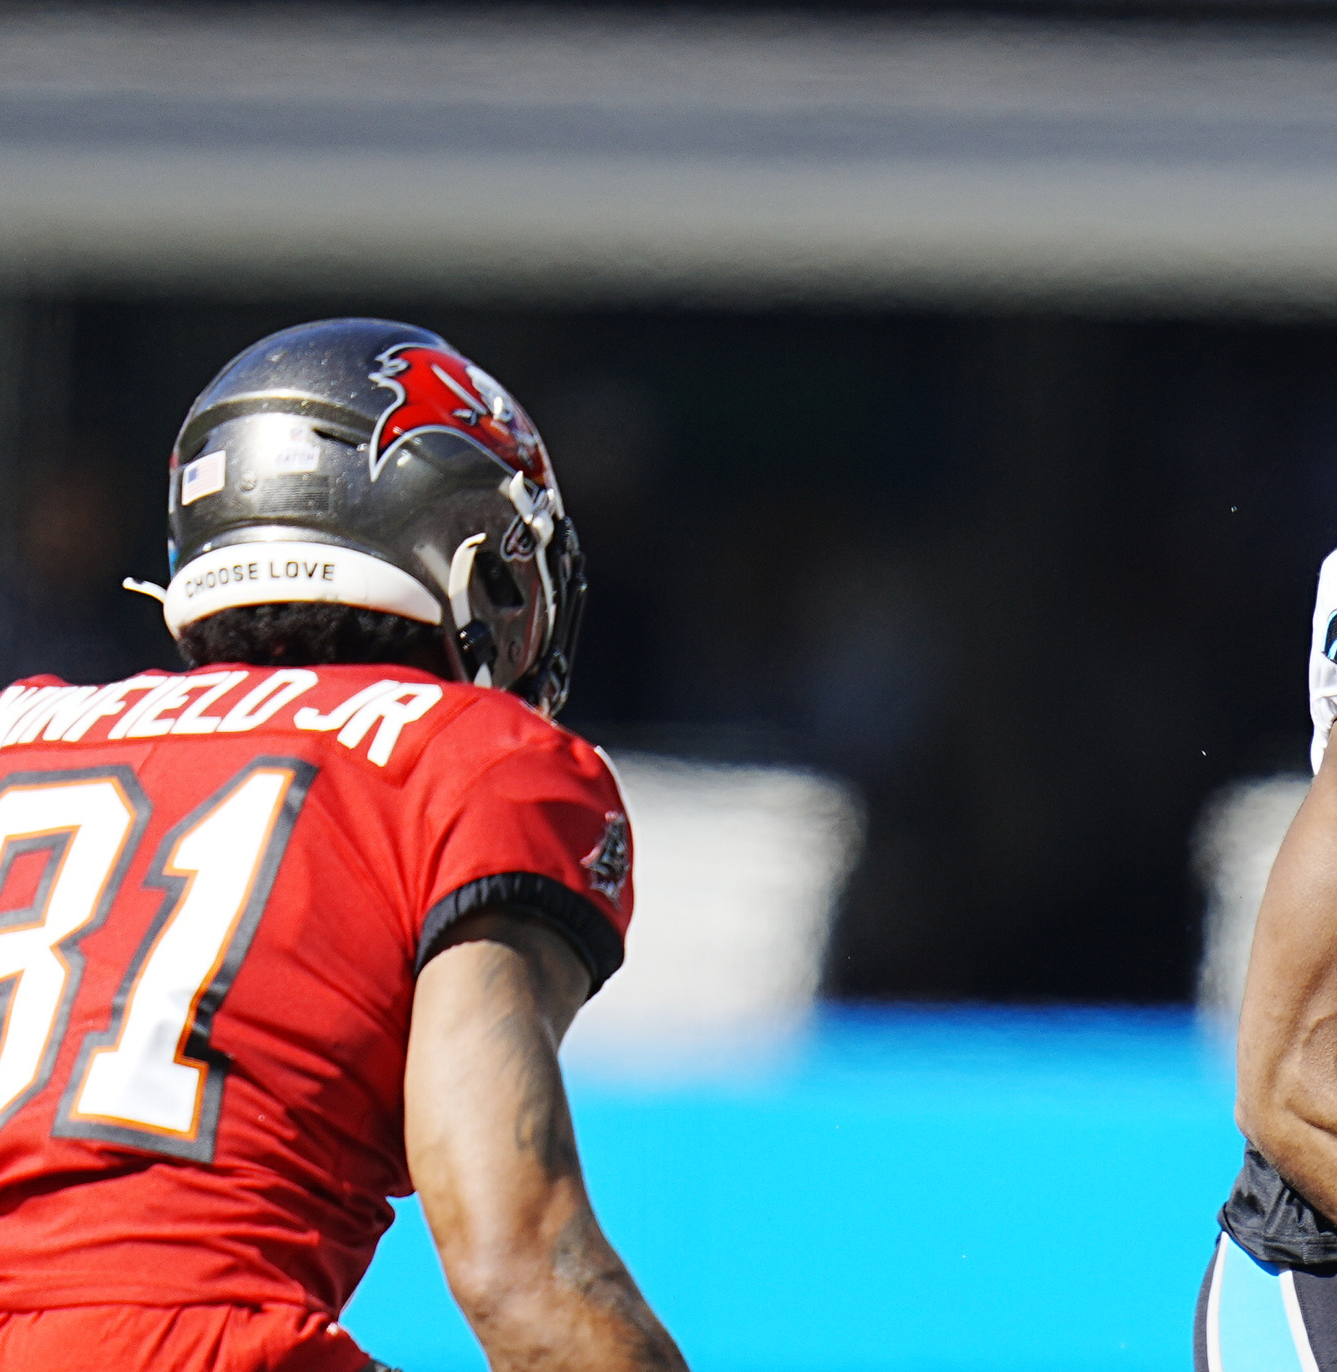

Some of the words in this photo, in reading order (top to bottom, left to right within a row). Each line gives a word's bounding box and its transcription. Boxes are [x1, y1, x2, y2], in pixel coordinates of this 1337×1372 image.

[184, 562, 258, 598] CHOOSE
[269, 561, 336, 581] LOVE
[294, 679, 443, 768] JR
